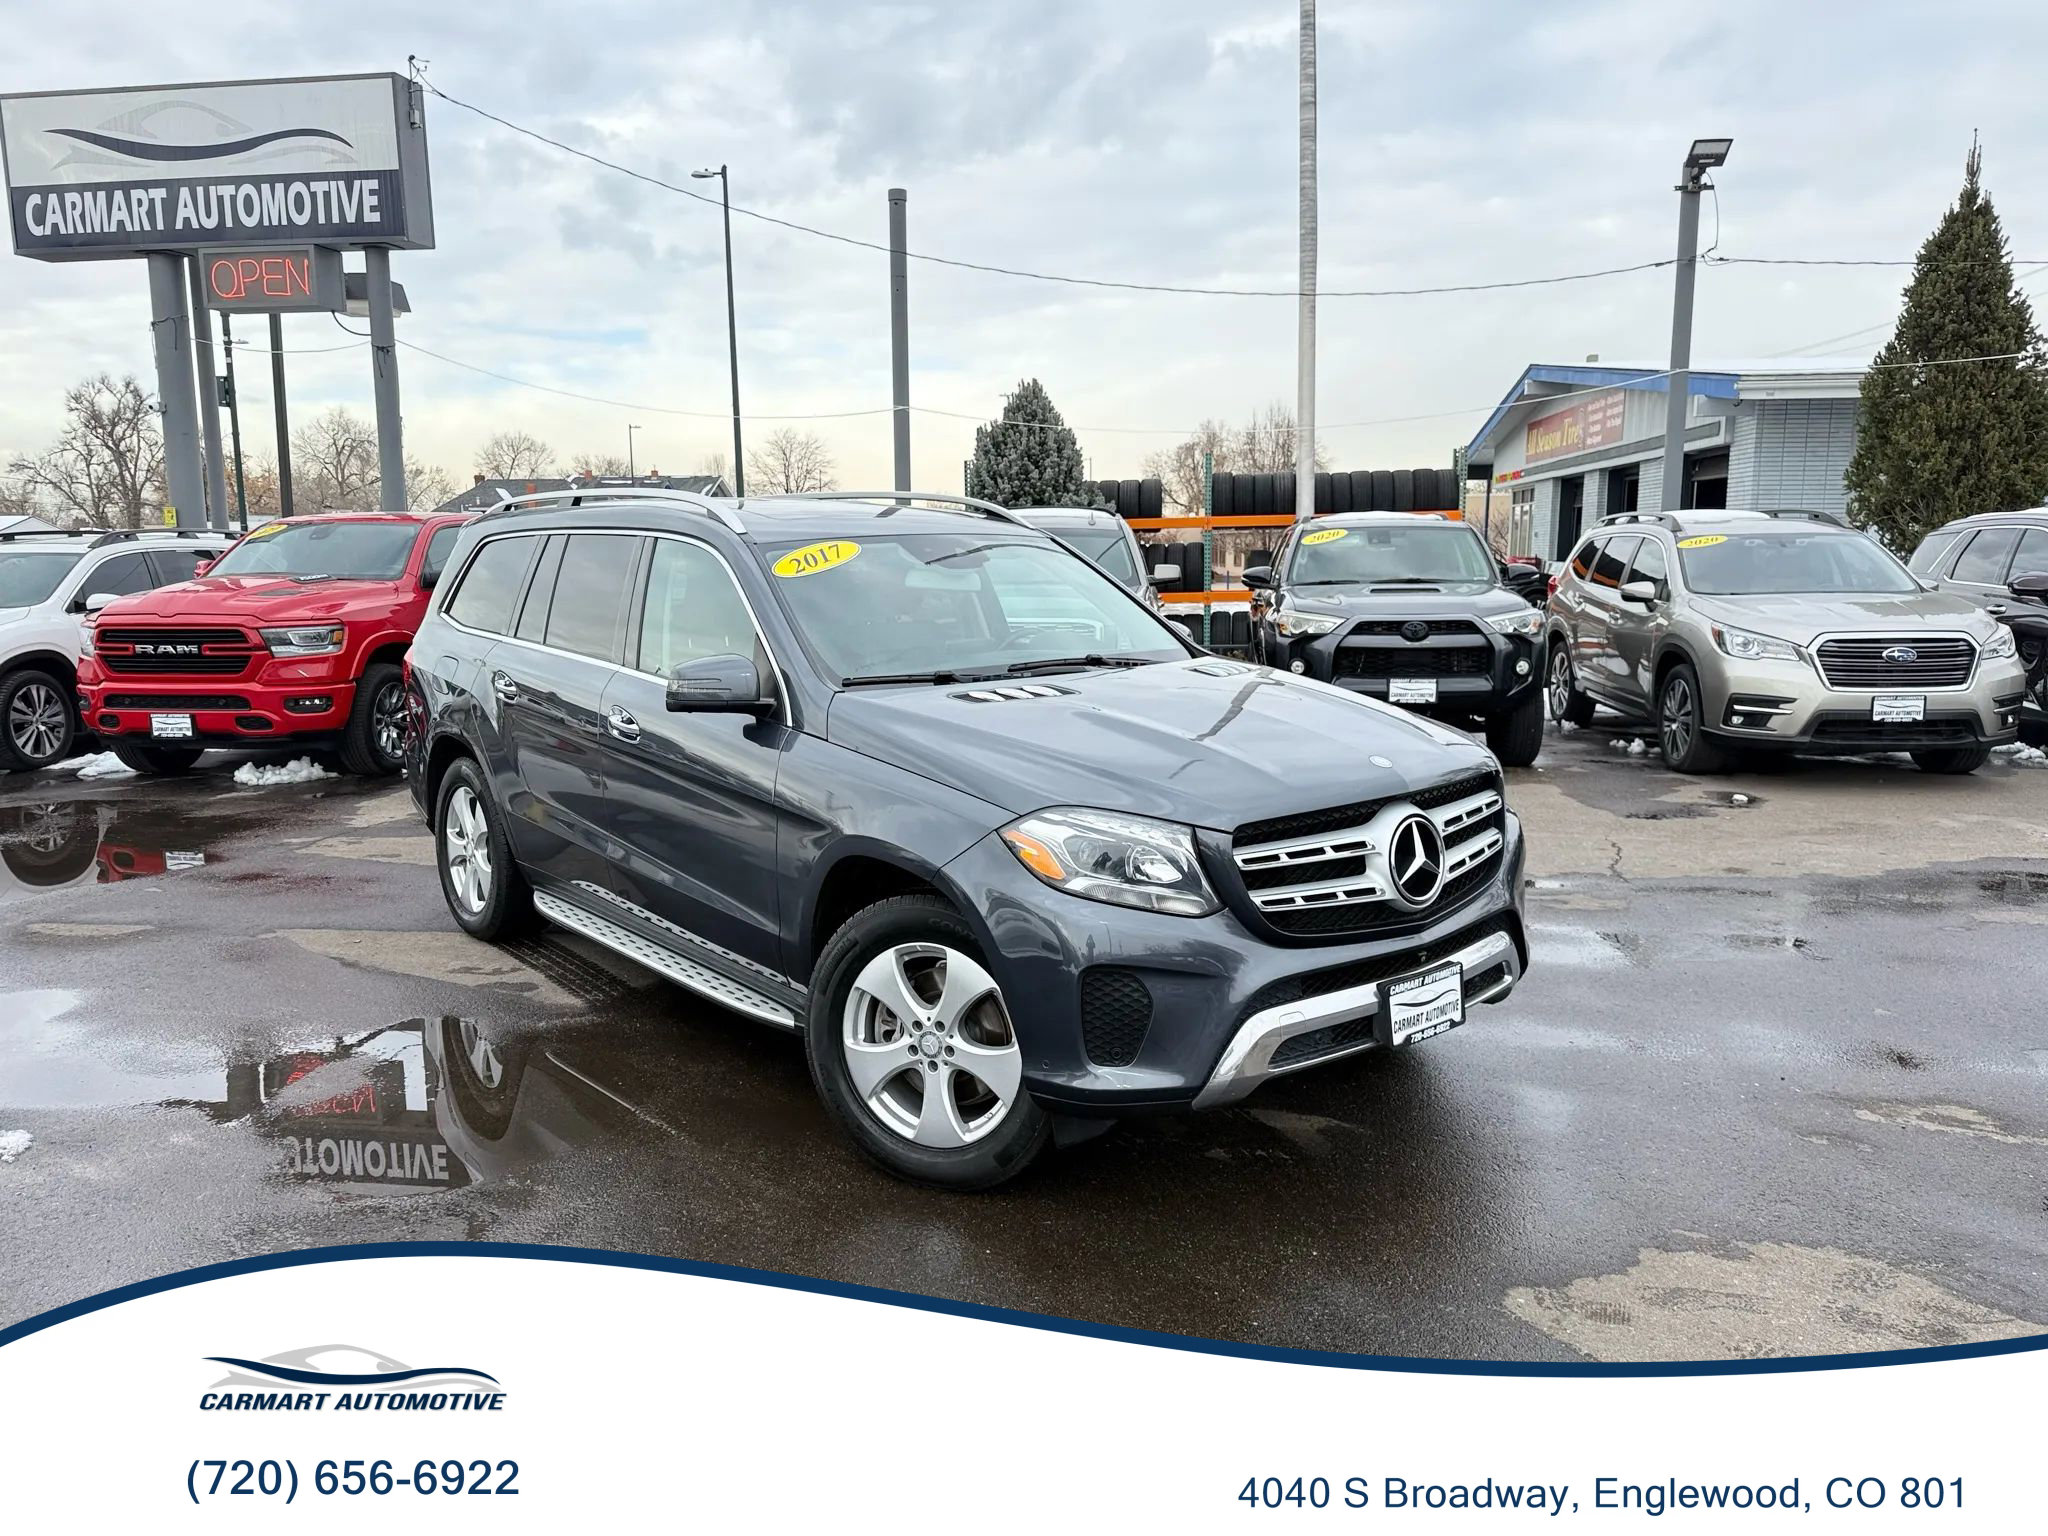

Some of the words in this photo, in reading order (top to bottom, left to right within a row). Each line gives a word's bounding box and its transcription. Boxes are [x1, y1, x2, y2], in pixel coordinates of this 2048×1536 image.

[25, 188, 167, 236] CARMART
[175, 179, 381, 230] AUTOMOTIVE
[211, 256, 312, 299] OPEN
[789, 544, 840, 574] 2017
[135, 644, 198, 654] RAM
[1390, 977, 1423, 995] CARMART
[1425, 964, 1461, 985] AUTOMOTIVE
[1394, 1012, 1424, 1034] CARMART
[1426, 999, 1459, 1022] AUTOMOTIVE
